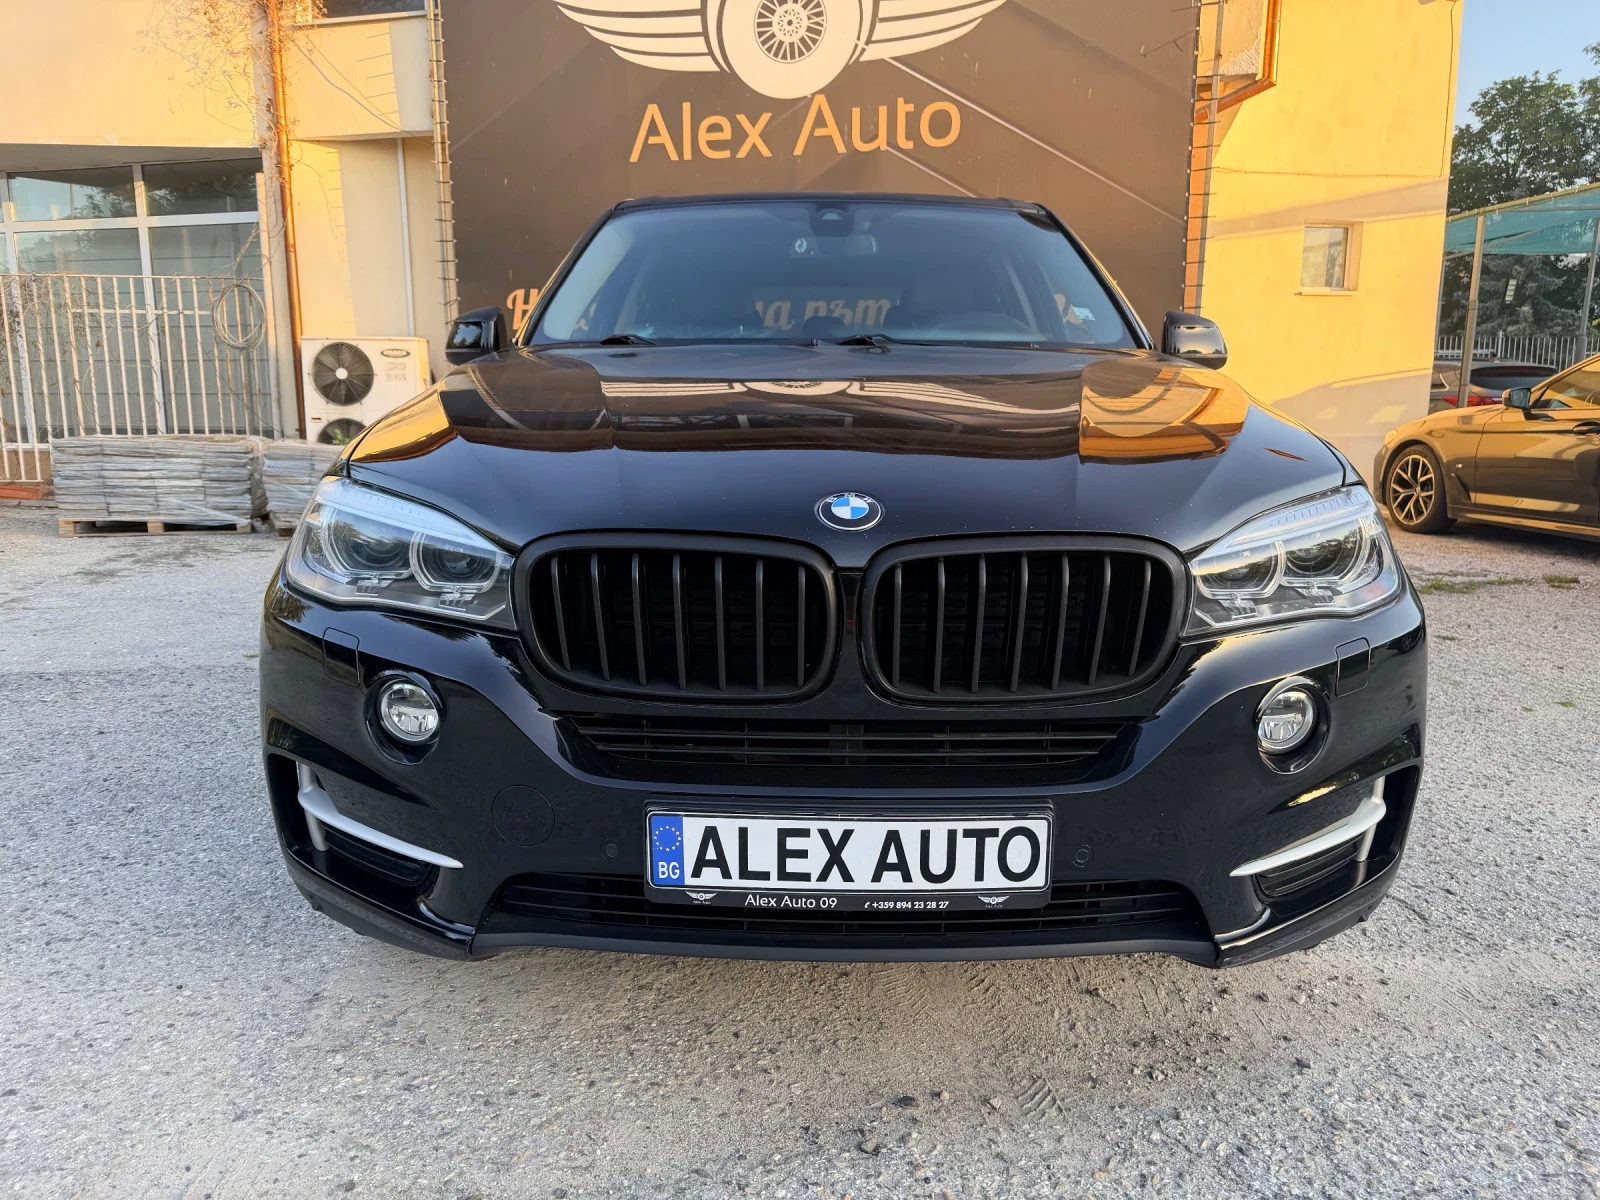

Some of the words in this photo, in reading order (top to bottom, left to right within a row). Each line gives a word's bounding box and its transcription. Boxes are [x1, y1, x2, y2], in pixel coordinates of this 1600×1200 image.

[629, 101, 773, 162] Alex
[793, 94, 961, 155] Auto
[690, 825, 855, 883] ALEX
[870, 826, 1041, 884] AUTO
[658, 861, 681, 880] BG
[744, 894, 777, 907] Alex
[780, 896, 816, 908] Auto
[819, 897, 838, 909] 09
[871, 901, 894, 909] +359
[896, 901, 912, 909] 894
[913, 901, 924, 909] 23
[926, 901, 937, 909] 28
[938, 901, 950, 909] 27
